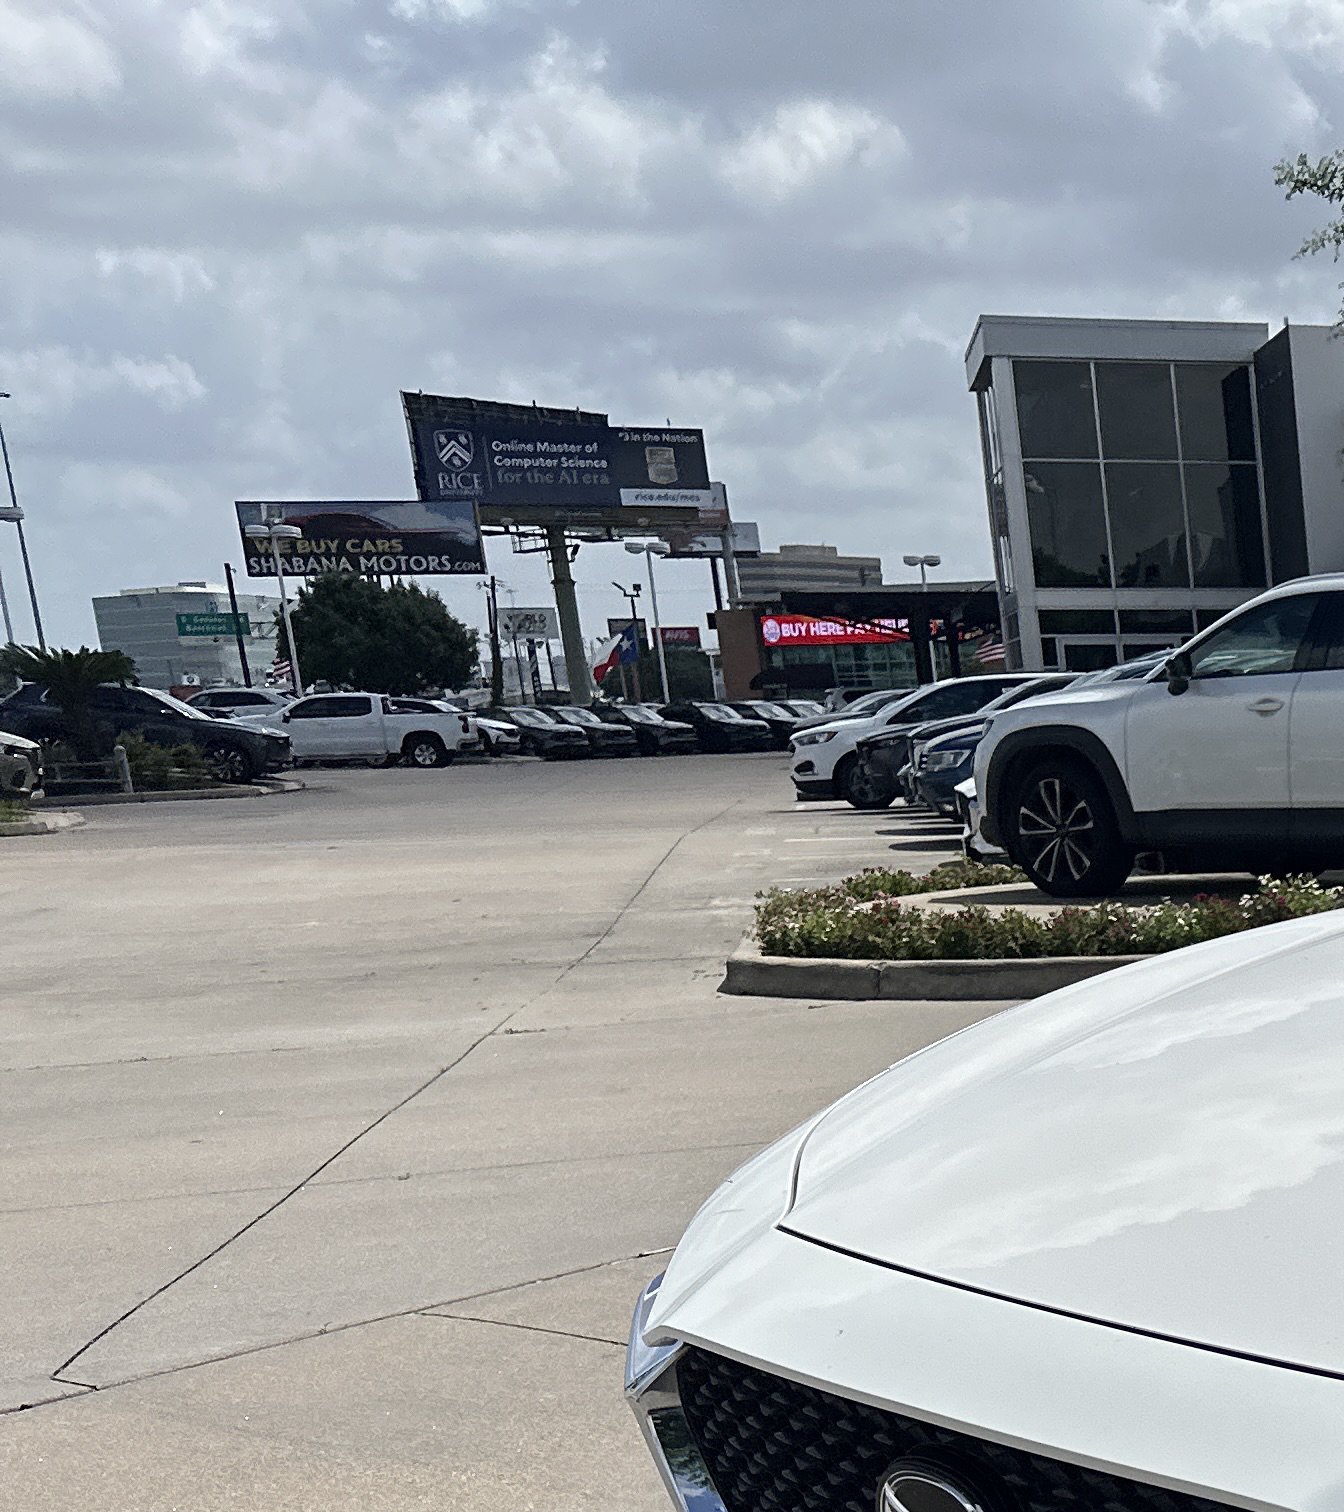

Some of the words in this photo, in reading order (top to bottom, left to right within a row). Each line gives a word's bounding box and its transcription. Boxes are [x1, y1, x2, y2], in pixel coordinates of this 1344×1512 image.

[643, 433, 660, 442] the
[662, 433, 698, 443] Nation
[491, 440, 533, 452] Online
[536, 441, 582, 453] Master
[585, 442, 598, 453] of
[494, 456, 558, 468] Computer
[560, 456, 608, 469] Science
[438, 472, 484, 490] RICE
[497, 470, 522, 484] for
[527, 470, 554, 484] the
[558, 470, 577, 485] AI
[582, 473, 610, 485] era
[254, 538, 291, 553] WE
[297, 538, 339, 553] BUY
[346, 538, 403, 553] CARS
[249, 557, 353, 573] SHABANA
[781, 622, 807, 637] BUY
[809, 621, 845, 637] HERE
